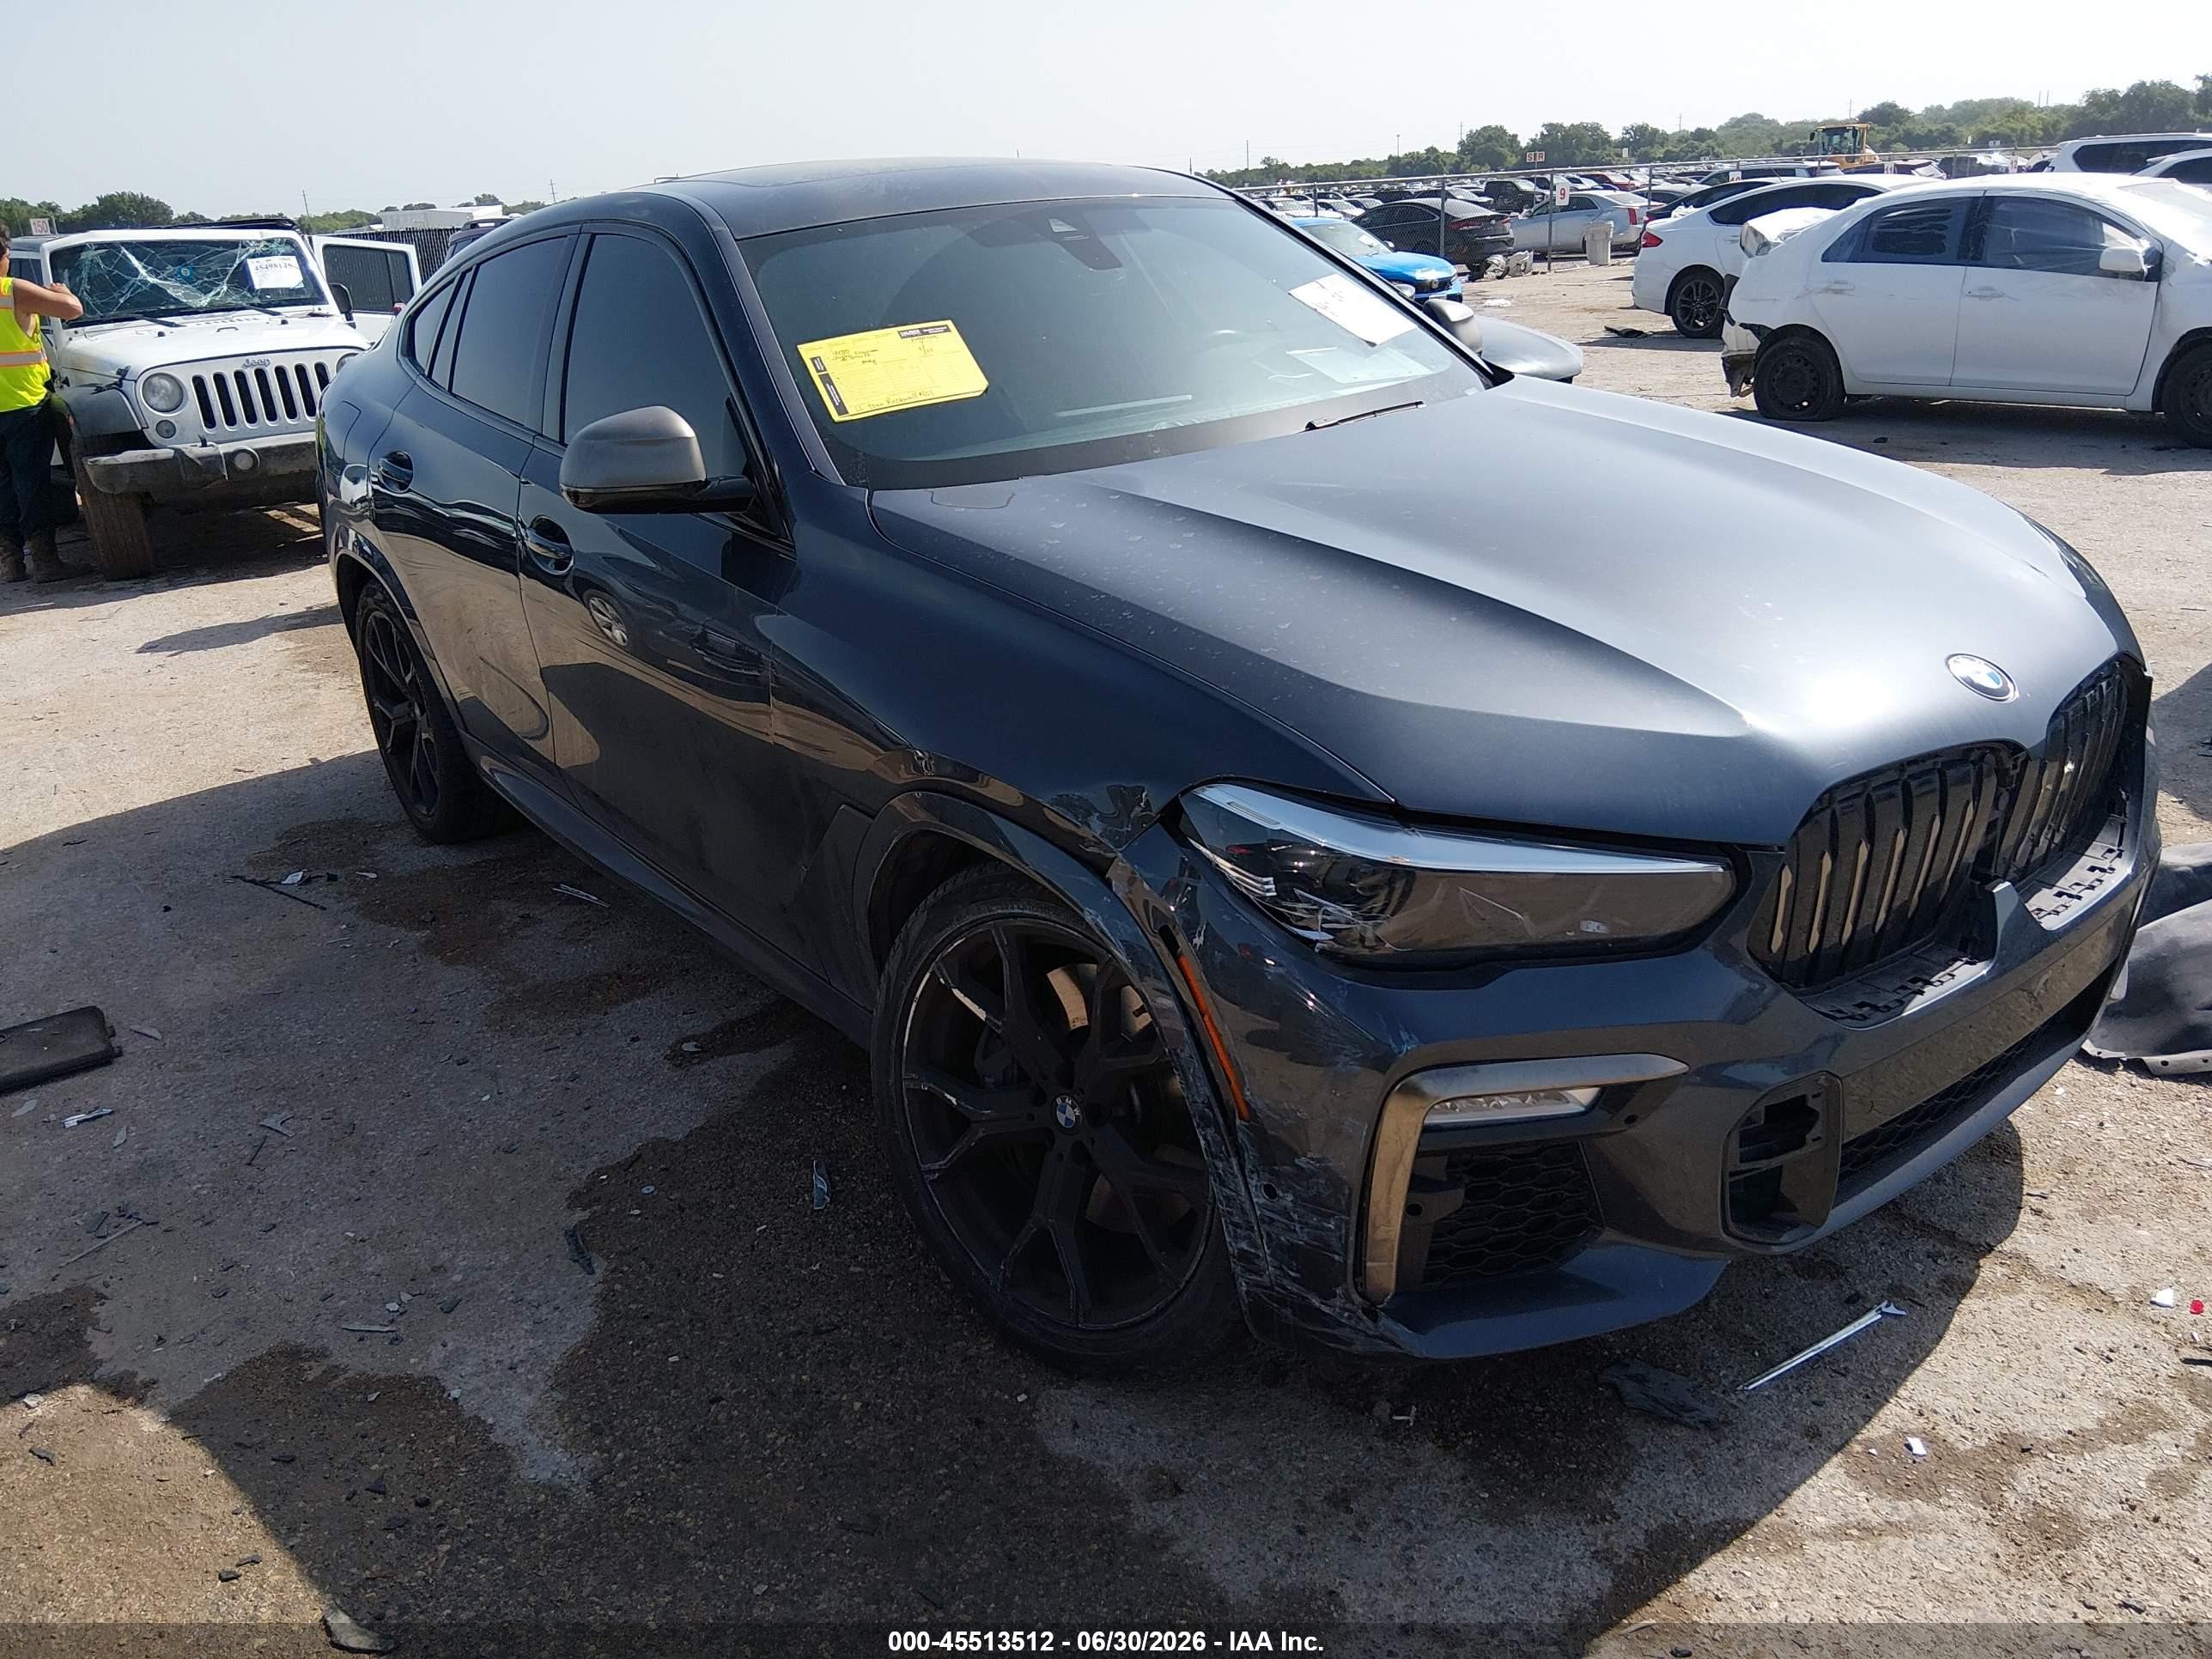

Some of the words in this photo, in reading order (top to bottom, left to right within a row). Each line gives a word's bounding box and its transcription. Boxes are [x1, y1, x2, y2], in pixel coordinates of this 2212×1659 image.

[1559, 187, 1566, 199] 9
[33, 220, 48, 234] 150
[241, 358, 271, 369] Jeep
